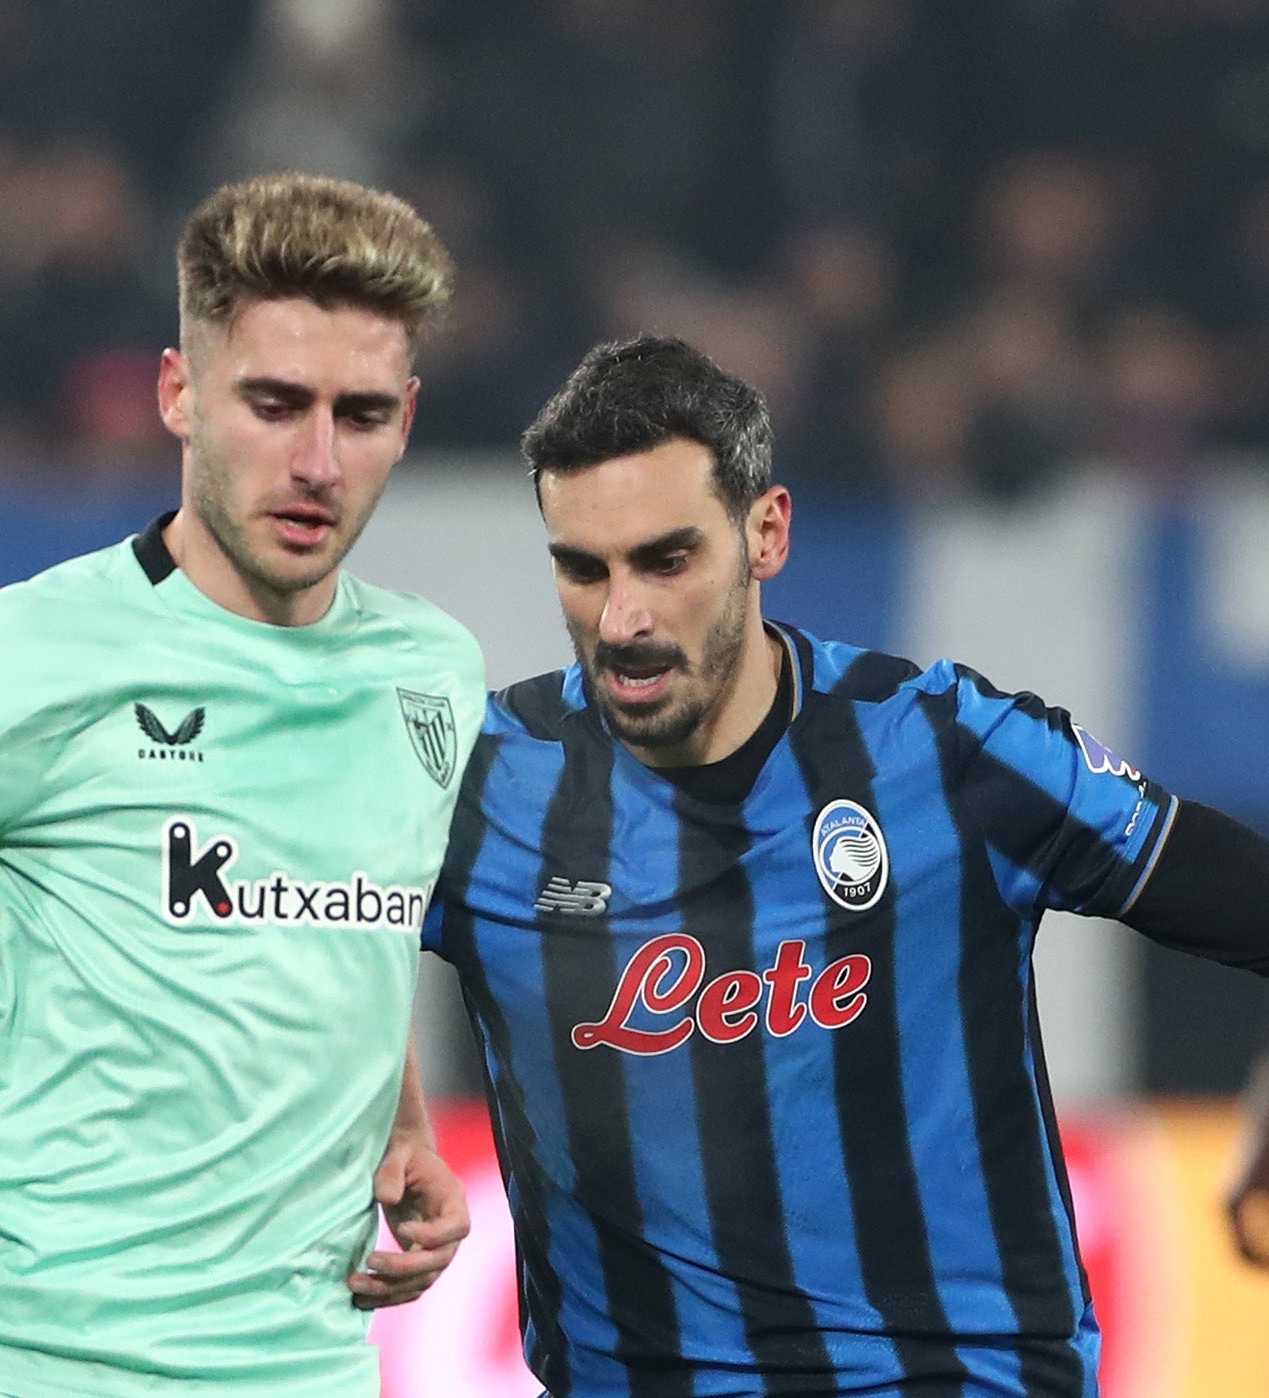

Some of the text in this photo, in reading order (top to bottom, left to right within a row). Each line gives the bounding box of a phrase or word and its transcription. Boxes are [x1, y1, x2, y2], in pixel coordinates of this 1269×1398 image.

[821, 816, 867, 837] ATALANTA
[169, 822, 432, 927] Kutxaban
[844, 882, 871, 897] 1907
[571, 933, 872, 1056] Lete
